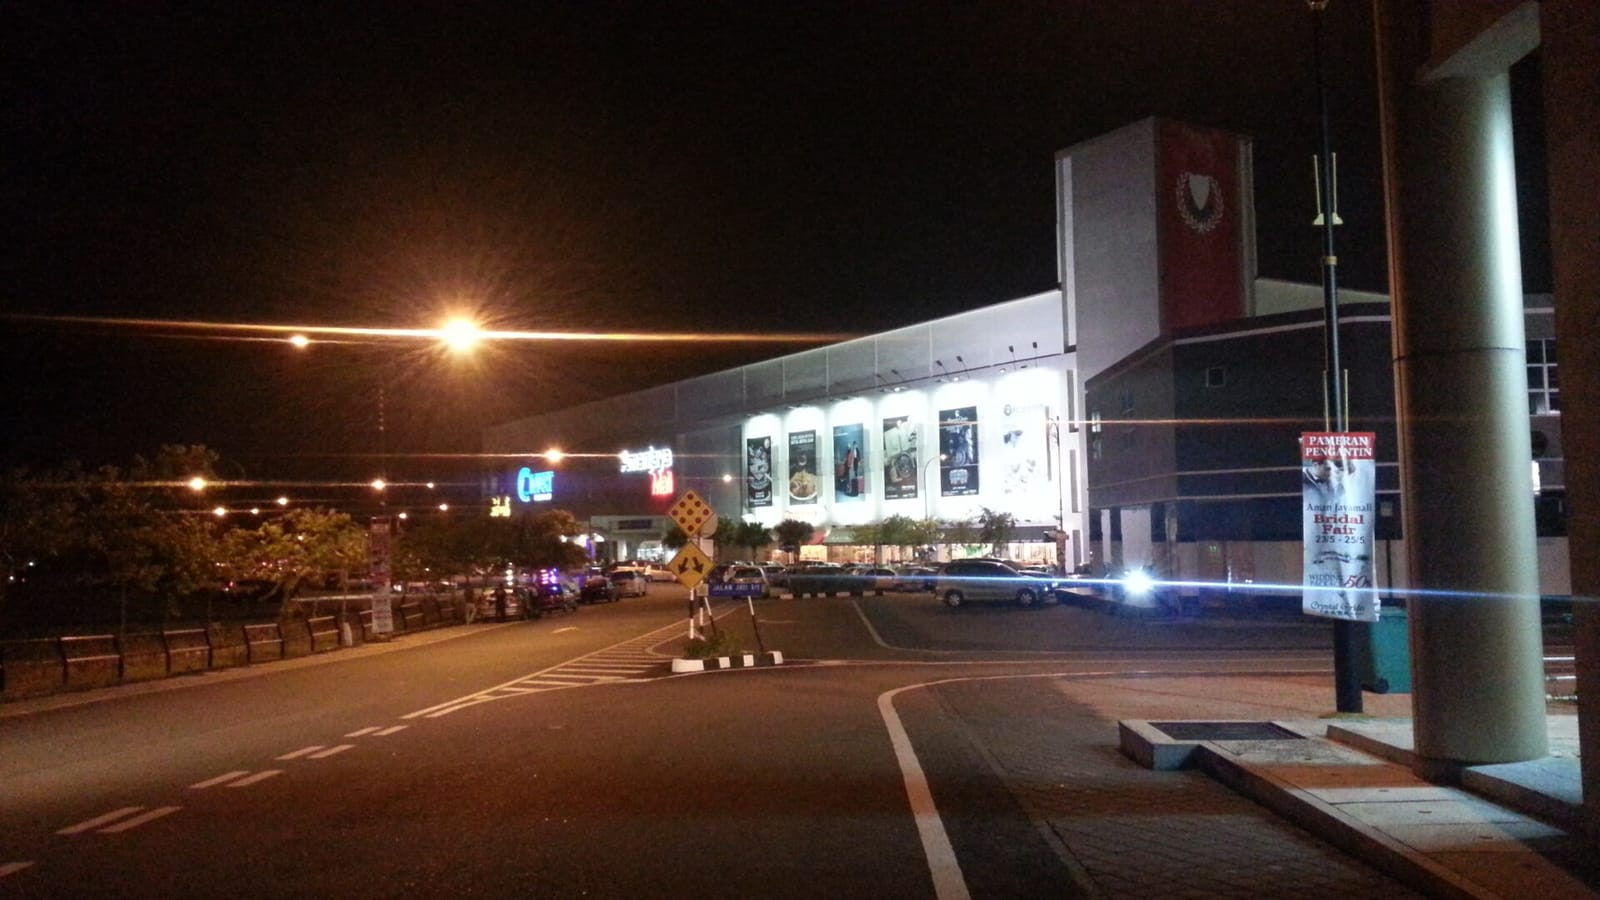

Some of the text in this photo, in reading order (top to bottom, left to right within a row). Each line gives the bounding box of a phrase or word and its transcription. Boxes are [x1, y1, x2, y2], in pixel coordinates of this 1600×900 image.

[1309, 435, 1369, 446] PAMERAN
[1305, 447, 1372, 457] PENGANTIN
[1307, 503, 1332, 512] Aman
[1314, 514, 1364, 525] Bridal
[1322, 525, 1356, 535] Fair
